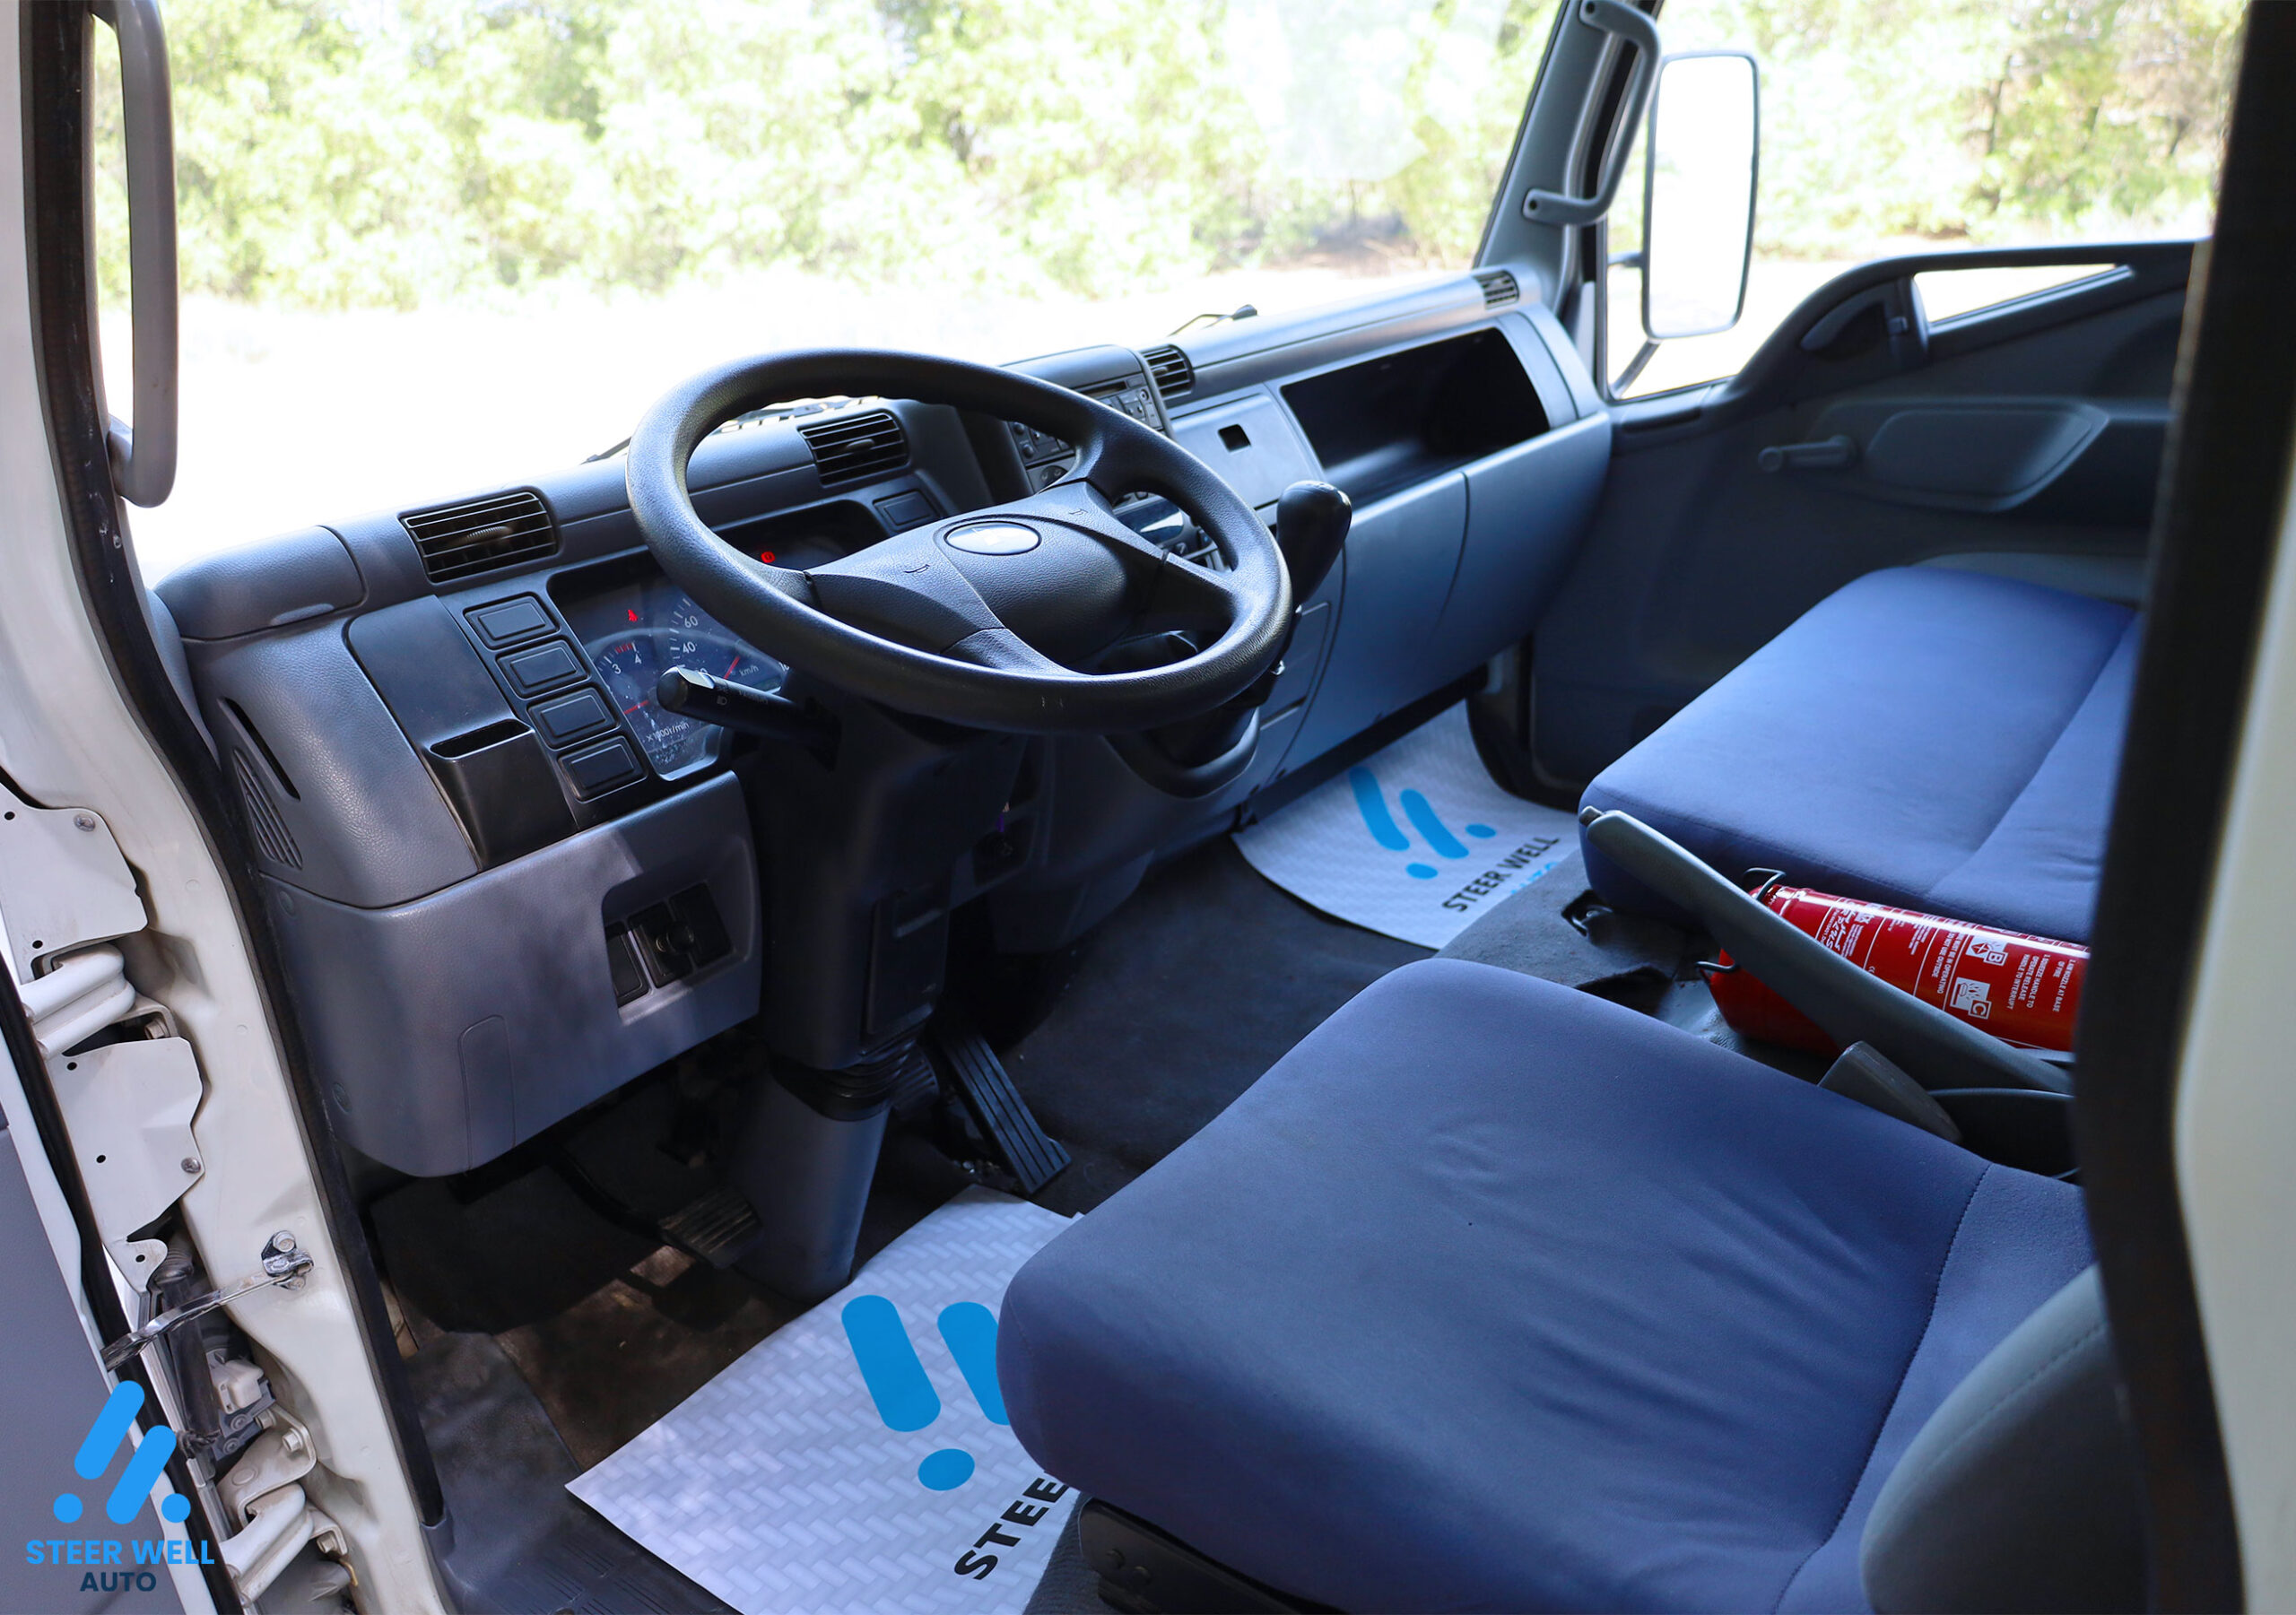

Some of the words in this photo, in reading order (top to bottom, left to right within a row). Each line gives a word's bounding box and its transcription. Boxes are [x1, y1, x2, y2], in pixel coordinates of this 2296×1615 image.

[684, 615, 698, 629] 60
[683, 641, 696, 654] 40
[634, 654, 642, 664] 4
[612, 664, 622, 674] 3
[739, 664, 760, 677] km/h
[1442, 870, 1512, 912] STEER
[1496, 837, 1561, 870] WELL
[1931, 955, 1944, 977] OUTSIDE
[1987, 951, 2002, 963] B
[2017, 953, 2030, 971] HANDLE
[2025, 955, 2039, 976] OPERATE
[2035, 957, 2048, 977] SQUEEZE
[2017, 976, 2031, 1001] RELEASE
[2028, 977, 2040, 999] HANDLE
[2058, 970, 2071, 989] NOZZLE
[2005, 978, 2021, 1009] INTERRUPT
[1971, 1001, 1987, 1015] C
[2025, 999, 2034, 1008] TO
[2052, 995, 2062, 1012] BASE
[954, 1477, 1070, 1580] STEE
